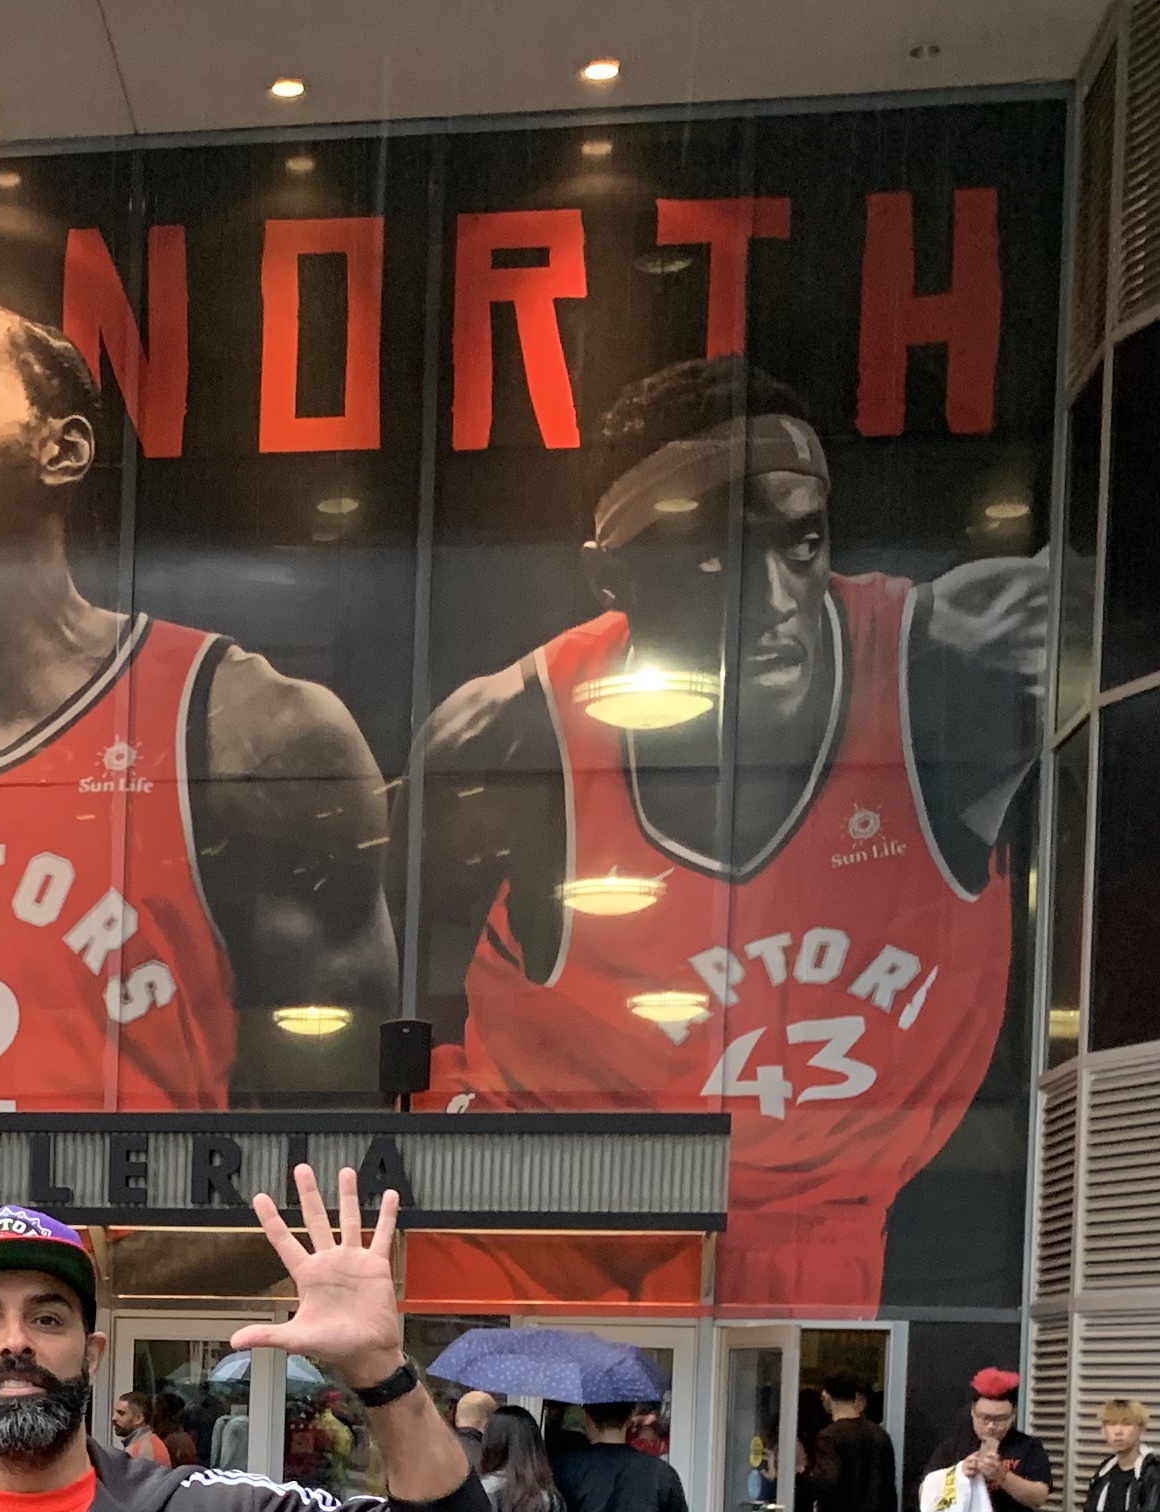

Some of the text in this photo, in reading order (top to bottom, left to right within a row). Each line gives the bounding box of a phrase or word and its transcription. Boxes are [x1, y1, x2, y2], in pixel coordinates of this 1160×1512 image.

[63, 187, 1001, 459] NORTH
[79, 776, 153, 793] Sun Life
[831, 840, 907, 869] Sun Life
[700, 1015, 877, 1120] 43
